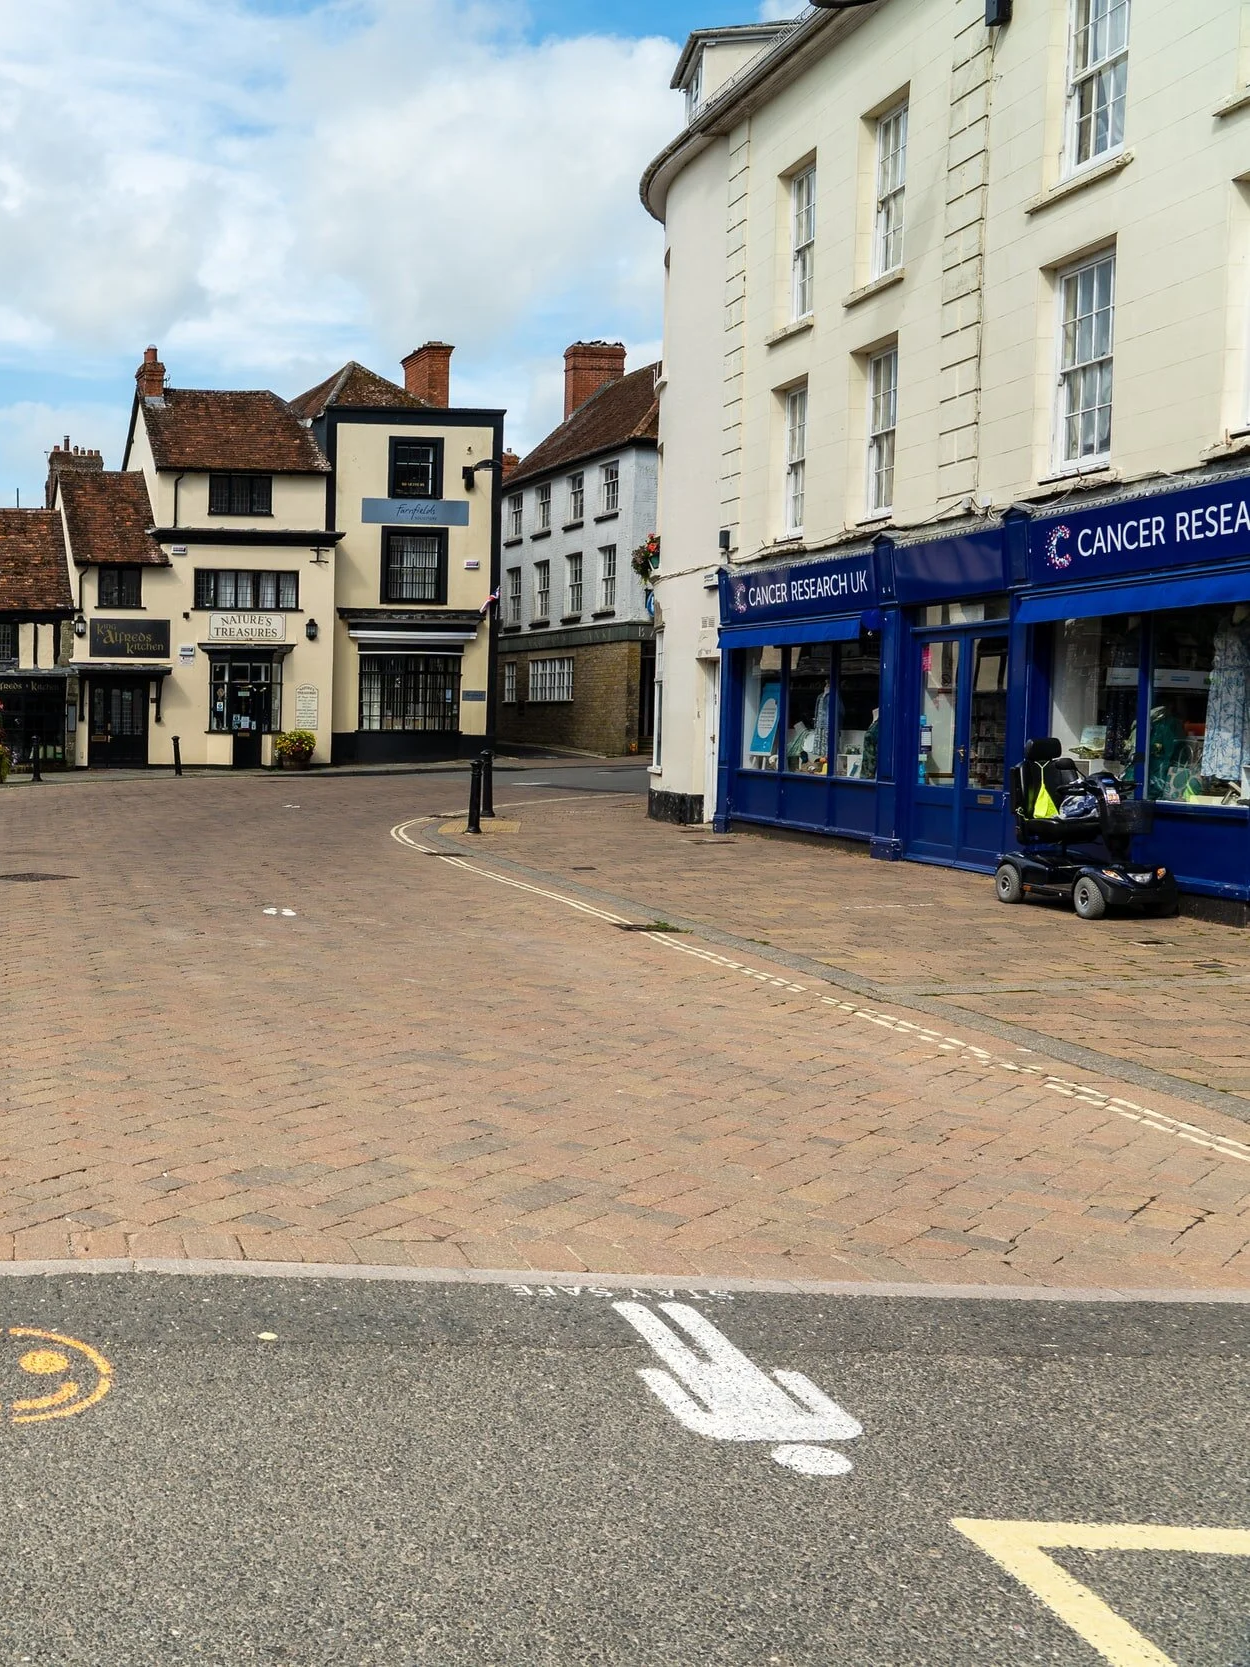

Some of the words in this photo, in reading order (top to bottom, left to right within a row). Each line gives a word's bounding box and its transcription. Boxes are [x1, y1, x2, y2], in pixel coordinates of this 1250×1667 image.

[396, 503, 436, 520] Farnfields
[1077, 516, 1166, 557] CANCER
[748, 583, 788, 607] CANCER
[791, 574, 848, 601] RESEARCH
[850, 570, 869, 593] UK
[221, 615, 272, 627] NATURE'S
[103, 629, 152, 644] Alfreds
[214, 627, 278, 638] TREASURES
[508, 1285, 614, 1298] SAFE
[631, 1288, 735, 1300] STAY
